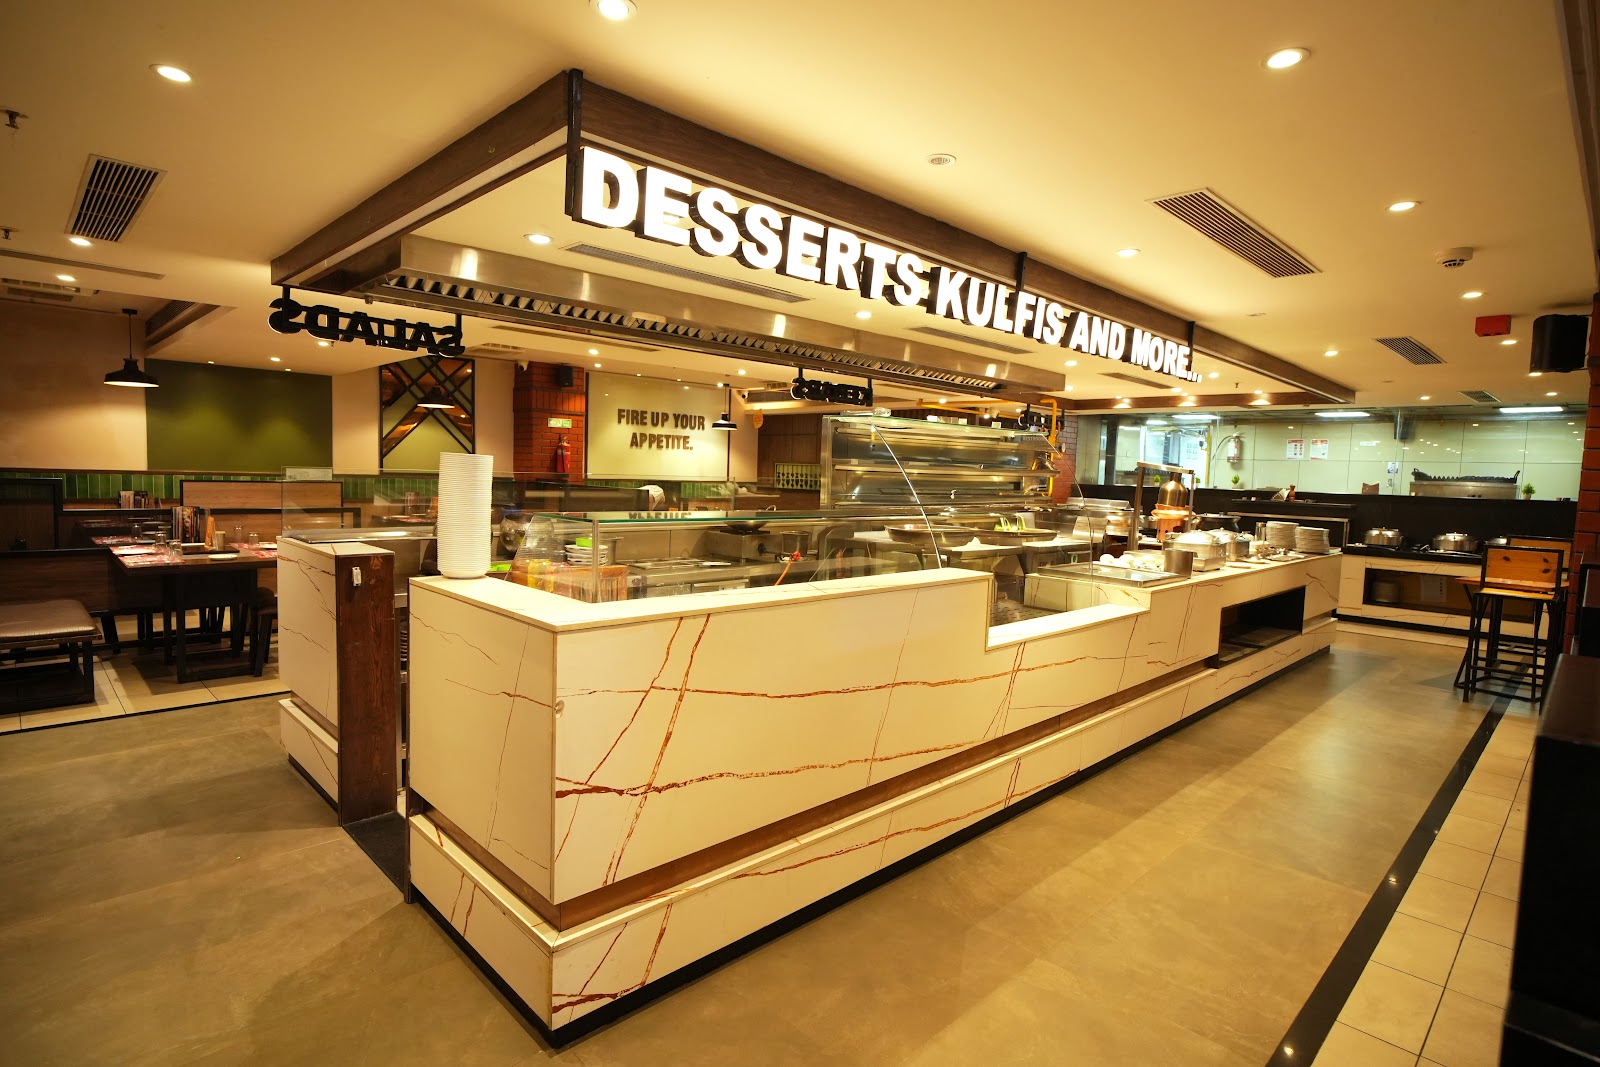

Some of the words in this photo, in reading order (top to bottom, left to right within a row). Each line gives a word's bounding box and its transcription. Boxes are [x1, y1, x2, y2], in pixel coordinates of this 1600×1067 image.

[580, 146, 923, 306] DESSERTS
[936, 266, 1064, 345] KULFIS
[1069, 311, 1126, 360] AND
[1130, 328, 1203, 383] MORE...
[617, 408, 648, 426] FIRE
[650, 411, 669, 428] UP
[673, 413, 705, 431] YOUR
[630, 432, 693, 450] APPETITE.
